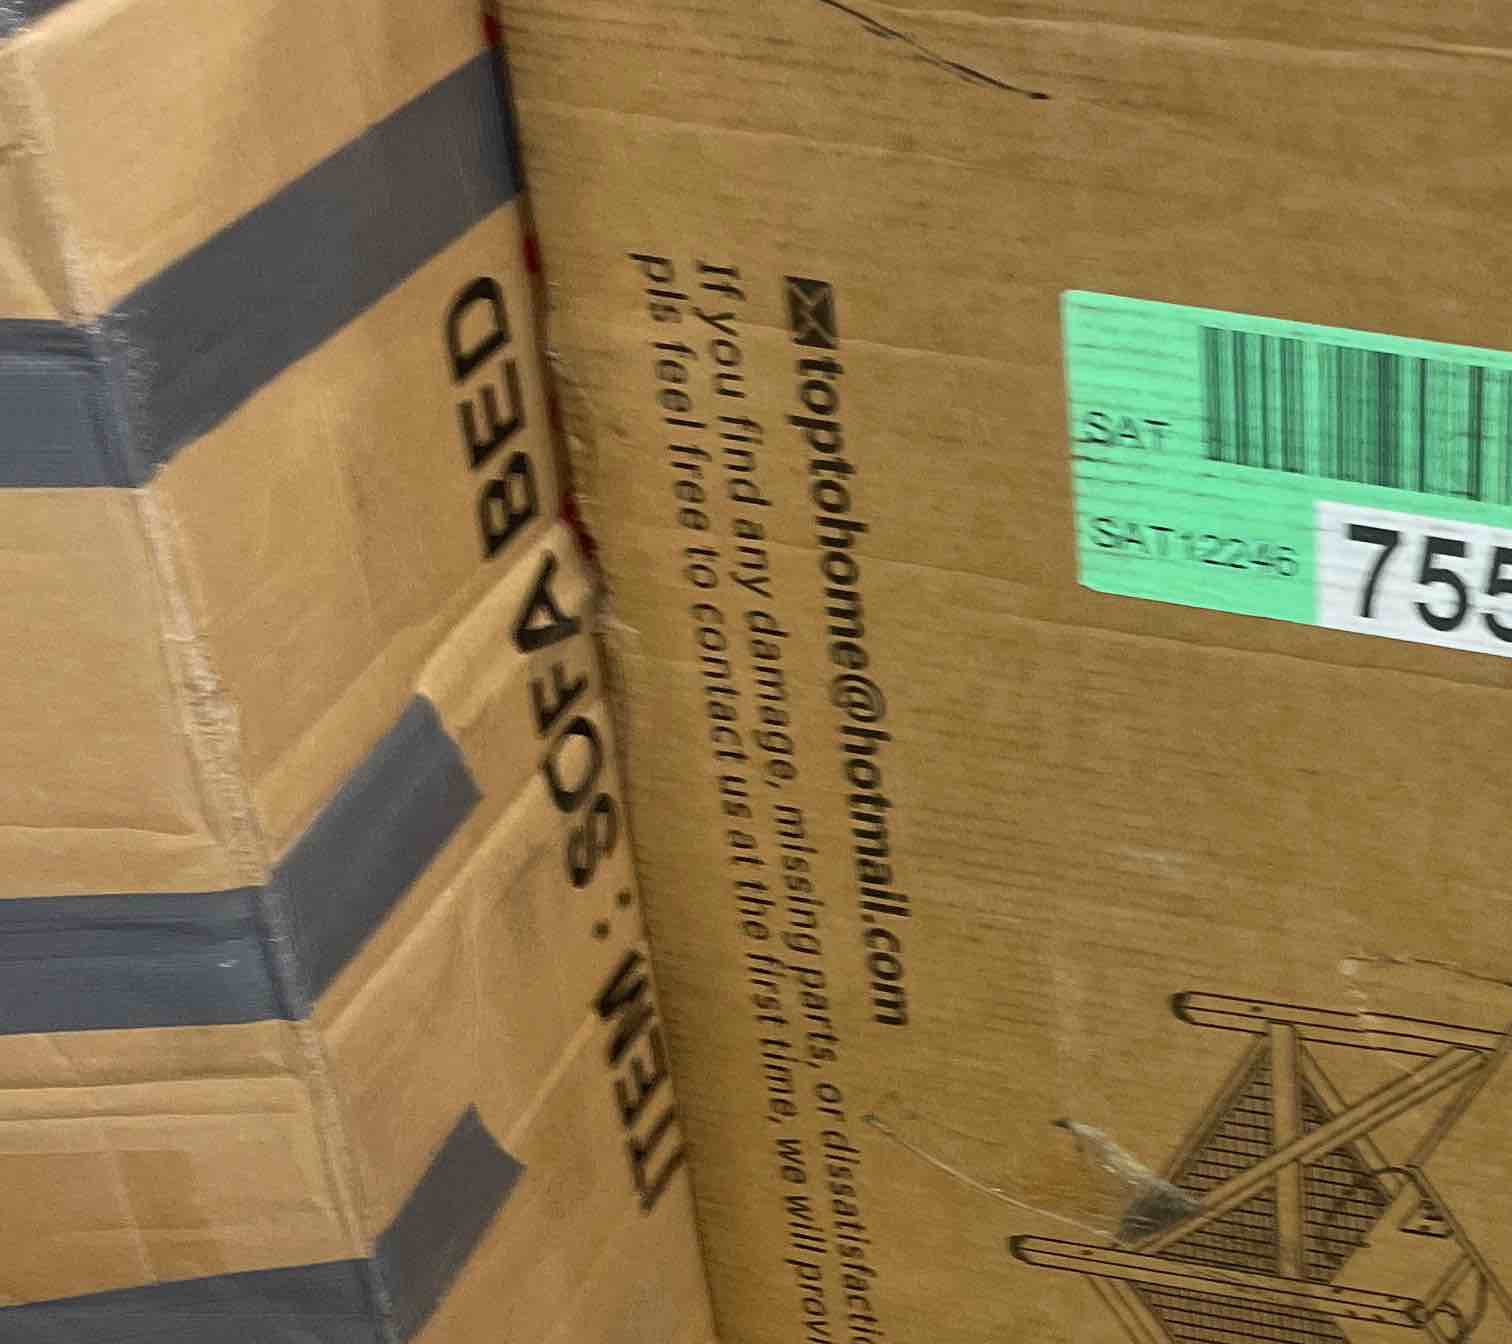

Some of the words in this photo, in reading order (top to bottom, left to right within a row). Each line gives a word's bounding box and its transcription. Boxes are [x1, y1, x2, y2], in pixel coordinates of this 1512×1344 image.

[628, 253, 690, 324] pls
[698, 262, 746, 302] If
[652, 340, 708, 429] feel
[692, 305, 746, 400] you
[443, 275, 539, 561] BED
[1081, 410, 1173, 451] SAT
[667, 444, 714, 532] free
[717, 414, 774, 508] find
[683, 546, 721, 590] to
[728, 518, 774, 599] any
[511, 549, 619, 890] SOFA
[690, 602, 751, 761] contact
[742, 609, 797, 789] damage,
[787, 356, 912, 1027] toptohome@hotmail.com
[718, 773, 754, 819] us
[725, 829, 766, 866] at
[772, 804, 825, 956] missing
[734, 880, 776, 941] the
[745, 952, 789, 1025] first
[785, 964, 841, 1069] parts,
[758, 1037, 801, 1124] time,
[815, 1081, 846, 1123] or
[774, 1138, 807, 1185] we
[783, 1195, 828, 1254] will
